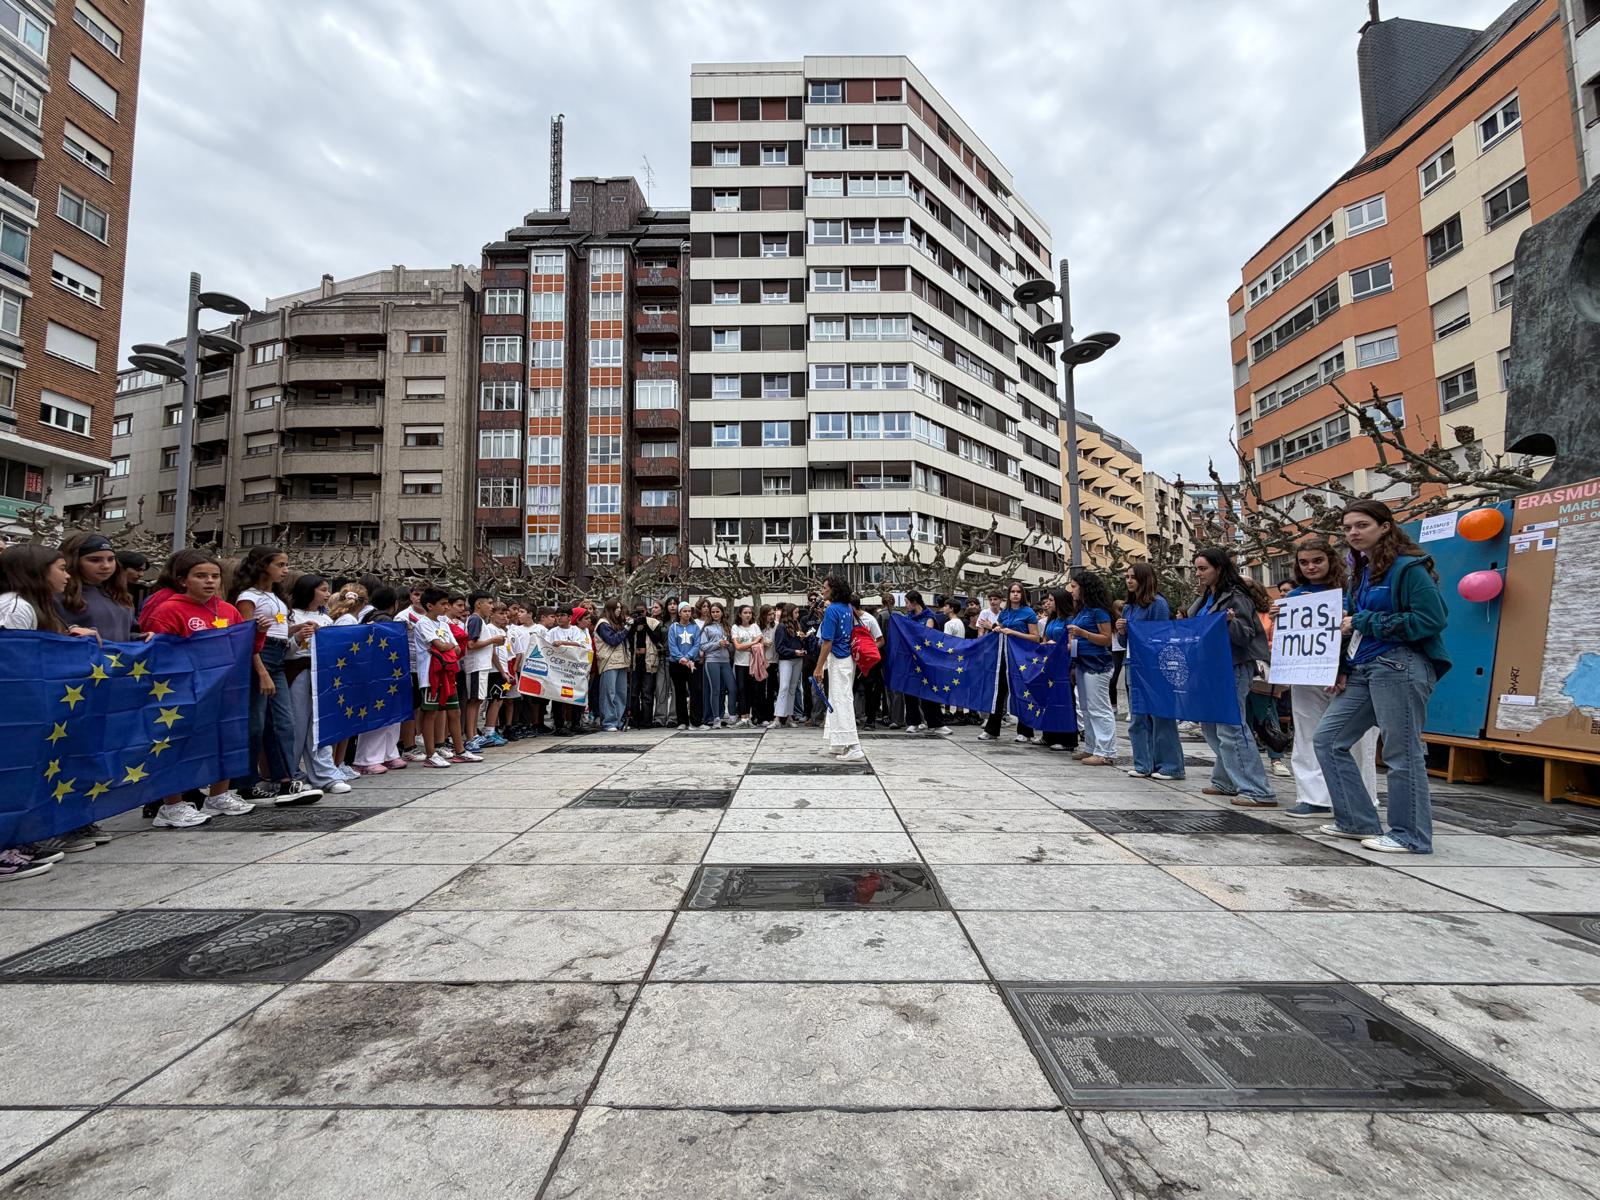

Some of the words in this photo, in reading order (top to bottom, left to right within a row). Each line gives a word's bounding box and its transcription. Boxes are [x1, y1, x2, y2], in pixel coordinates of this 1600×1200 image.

[1573, 513, 1586, 522] DE
[1277, 603, 1330, 630] Eras
[1508, 666, 1520, 695] SMART
